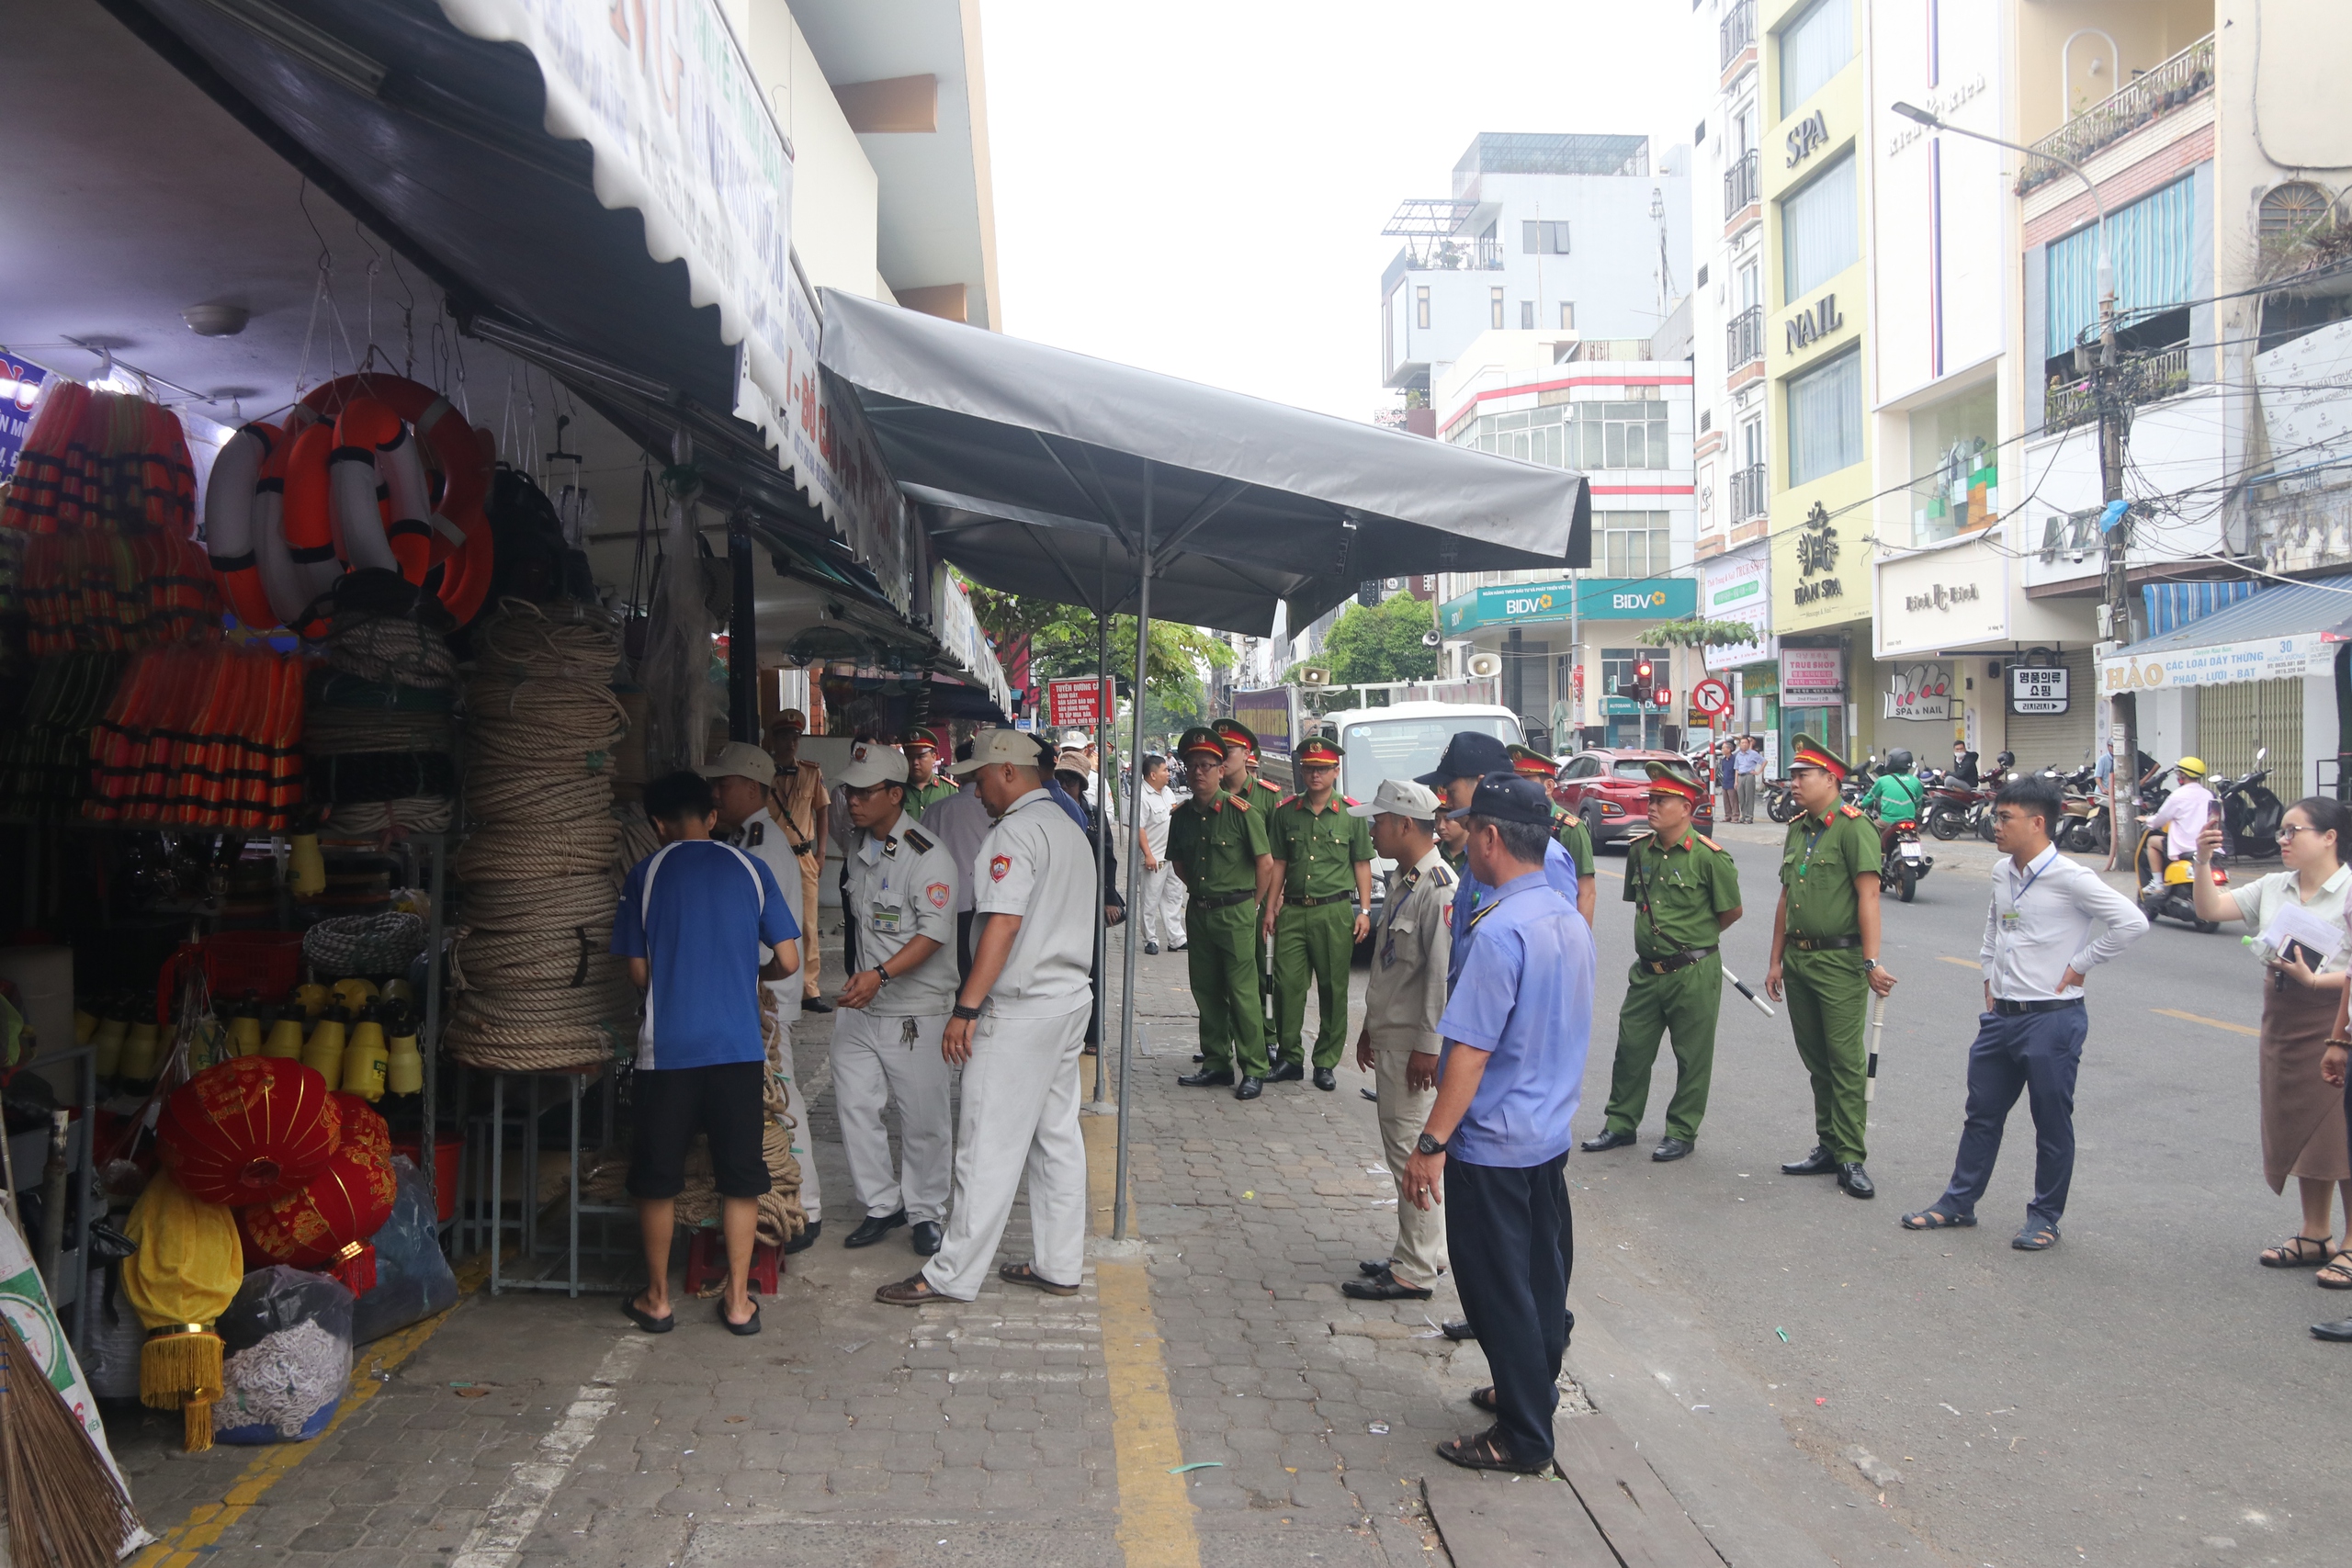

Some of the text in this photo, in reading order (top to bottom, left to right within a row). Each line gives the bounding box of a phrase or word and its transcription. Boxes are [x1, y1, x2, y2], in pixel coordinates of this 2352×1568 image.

[1786, 109, 1830, 169] SPA
[1785, 293, 1845, 355] NAIL
[1949, 582, 1980, 603] Rich
[1506, 598, 1541, 615] BIDV
[1613, 593, 1652, 609] BIDV
[2279, 640, 2292, 653] 30
[2165, 659, 2185, 671] CÁC
[2187, 656, 2207, 671] LOẠI
[2210, 654, 2228, 667] DÂY
[2019, 671, 2061, 683] 명품의류
[2106, 657, 2164, 690] HẢO
[2173, 668, 2256, 684] PHAO LƯỚI BẠT
[2030, 685, 2052, 696] 쇼핑
[1895, 707, 1912, 716] SPA
[1922, 705, 1943, 715] NAIL
